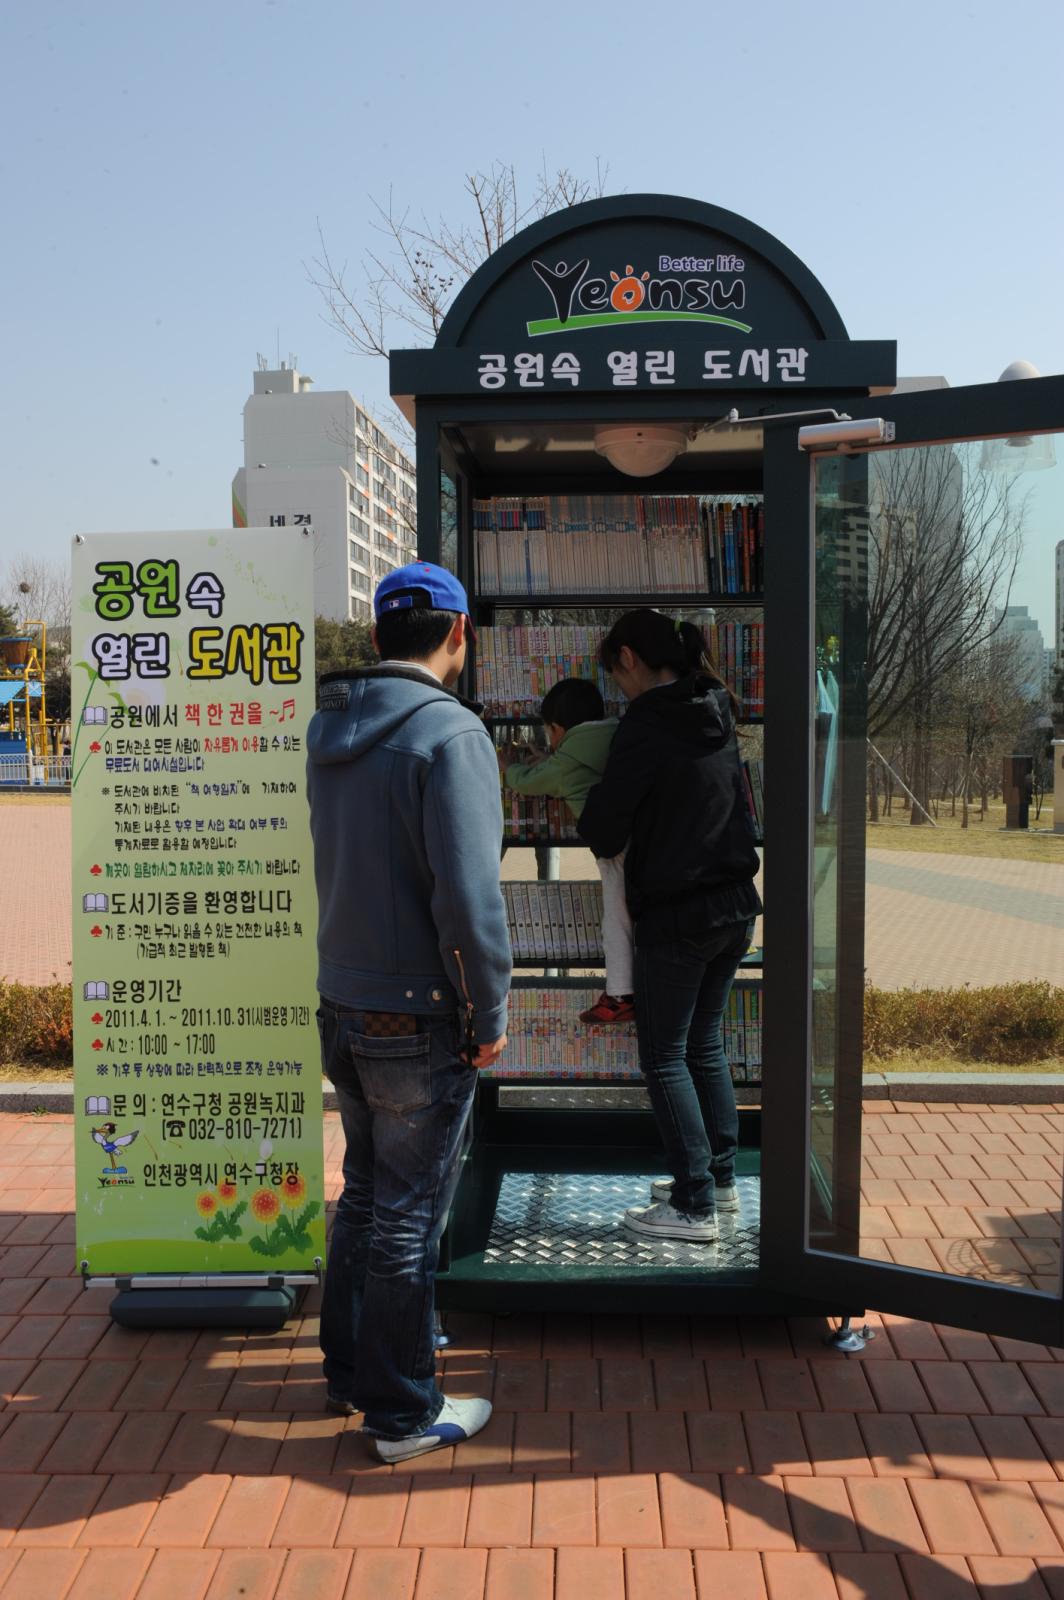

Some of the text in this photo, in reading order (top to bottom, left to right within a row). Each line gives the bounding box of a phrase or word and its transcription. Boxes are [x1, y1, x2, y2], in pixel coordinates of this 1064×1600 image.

[659, 254, 745, 272] Better life
[532, 258, 746, 324] Yeonsu
[478, 348, 808, 389] 공원속 열린 도서관
[92, 622, 304, 685] 열린 도서관
[110, 705, 178, 729] 공원에서
[185, 704, 200, 727] 책
[207, 703, 223, 726] 한
[230, 702, 262, 725] 권을
[105, 736, 300, 755] 이 도서관은 모든 사람이 자유롭게 이용할 수 있는
[106, 756, 204, 773] 무료도서 대여시설입니다
[115, 785, 149, 797] 도서관에
[153, 785, 179, 797] 비치된
[262, 782, 296, 793] 기재하여
[115, 802, 180, 815] 주시기 바랍니다
[115, 821, 140, 833] 기재된
[145, 820, 171, 832] 내용은
[175, 819, 192, 831] 향후
[208, 819, 224, 831] 사업
[229, 818, 245, 830] 확대
[250, 818, 266, 830] 여부
[271, 817, 287, 830] 등의
[115, 837, 236, 851] 통계자료로 활용할 예정입니다
[106, 862, 130, 878] 깨끗이
[134, 861, 176, 877] 열람하시고
[180, 861, 213, 876] 제자리에
[238, 860, 262, 875] 주시기
[266, 860, 300, 875] 바랍니다
[112, 890, 292, 916] 도서기증을 환영합니다
[135, 924, 150, 939] 구민
[155, 924, 180, 939] 누구나
[184, 923, 200, 939] 읽을
[205, 923, 212, 939] 수
[216, 923, 232, 938] 있는
[236, 923, 261, 938] 건전한
[265, 922, 290, 938] 내용의
[294, 921, 302, 937] 책
[169, 943, 186, 958] 최근
[190, 942, 215, 958] 발행된
[112, 980, 182, 1003] 운영기간
[139, 1035, 167, 1055] 10:00
[186, 1034, 215, 1054] 17:00
[147, 1062, 172, 1077] 상황에
[177, 1062, 193, 1076] 따라
[198, 1062, 242, 1076] 탄력적으로
[246, 1061, 262, 1076] 조정
[161, 1093, 221, 1117] 연수구청
[228, 1092, 305, 1116] 공원녹지과
[144, 1162, 299, 1187] 인천광역시 연수구청장
